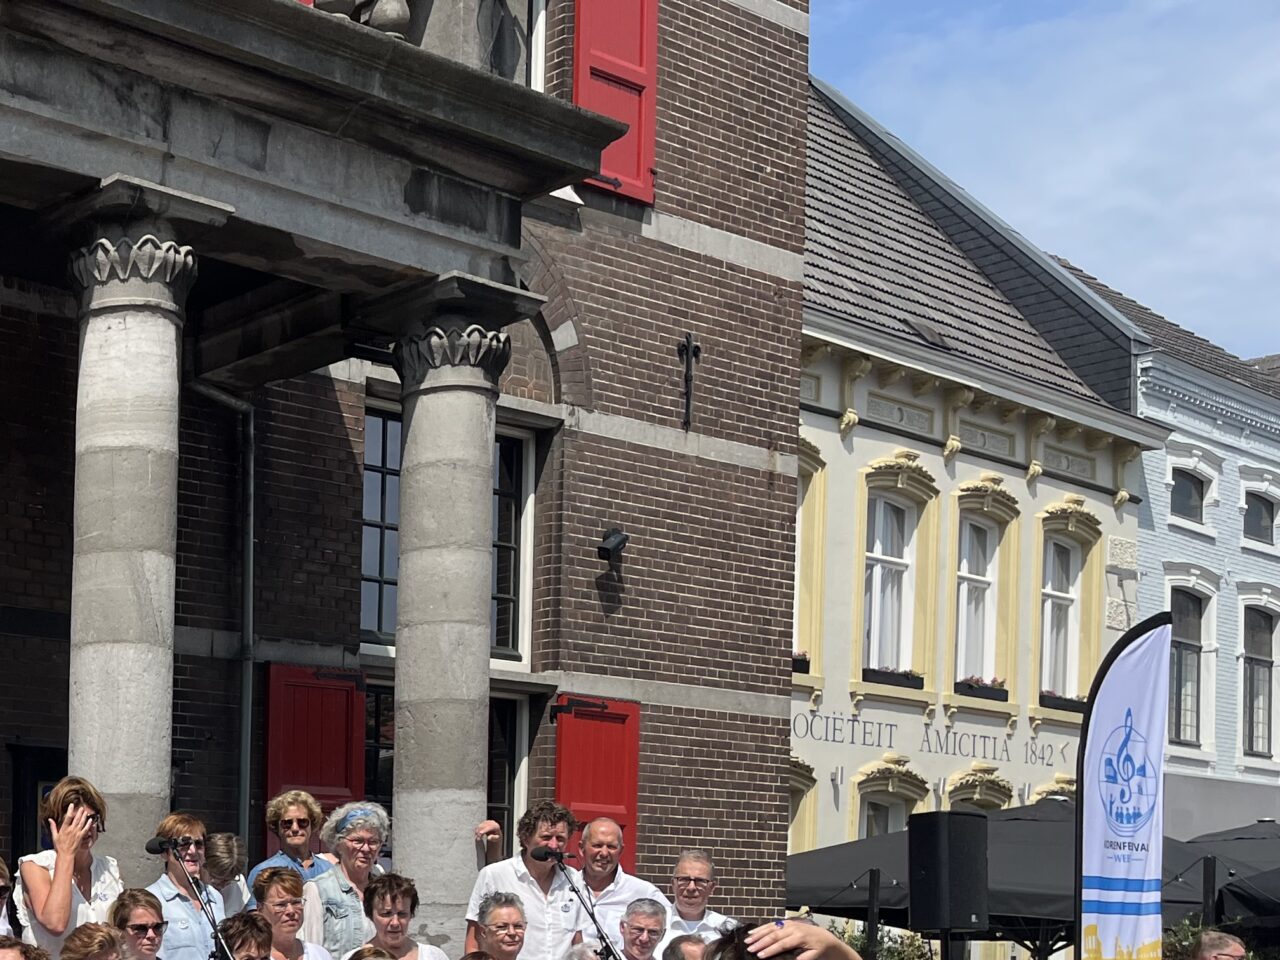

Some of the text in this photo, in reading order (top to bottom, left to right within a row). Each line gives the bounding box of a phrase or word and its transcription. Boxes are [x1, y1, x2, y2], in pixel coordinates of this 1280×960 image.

[793, 711, 1054, 767] OCIËTEIT AMICITIA 1842
